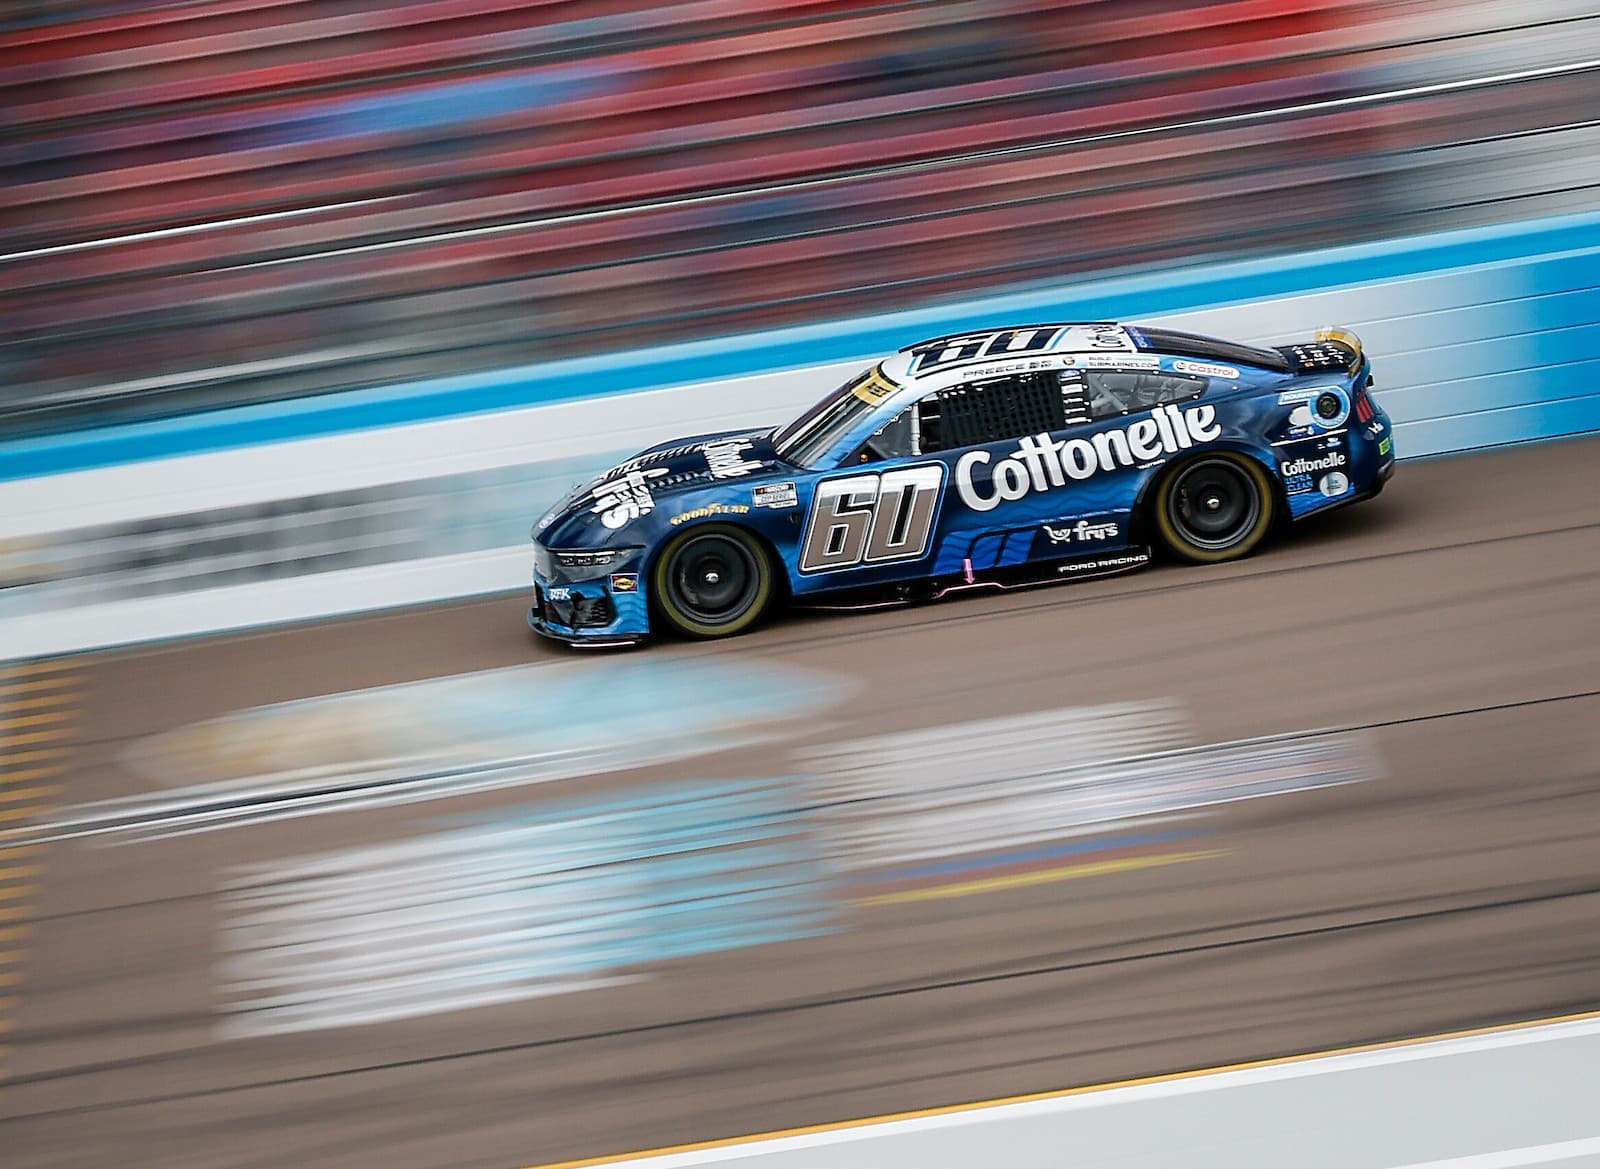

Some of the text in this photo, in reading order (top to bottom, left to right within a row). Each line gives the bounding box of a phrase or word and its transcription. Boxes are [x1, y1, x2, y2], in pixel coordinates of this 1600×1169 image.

[963, 358, 1025, 378] PREECE
[1188, 364, 1234, 377] Castrol
[955, 403, 1221, 512] Cottonelle
[1281, 452, 1346, 476] Cottonelle
[1286, 473, 1312, 484] ULTRA
[1287, 481, 1313, 491] CLEAN
[670, 502, 750, 525] GOODYEAR
[802, 464, 944, 571] 60
[1058, 555, 1149, 572] FORD RACING
